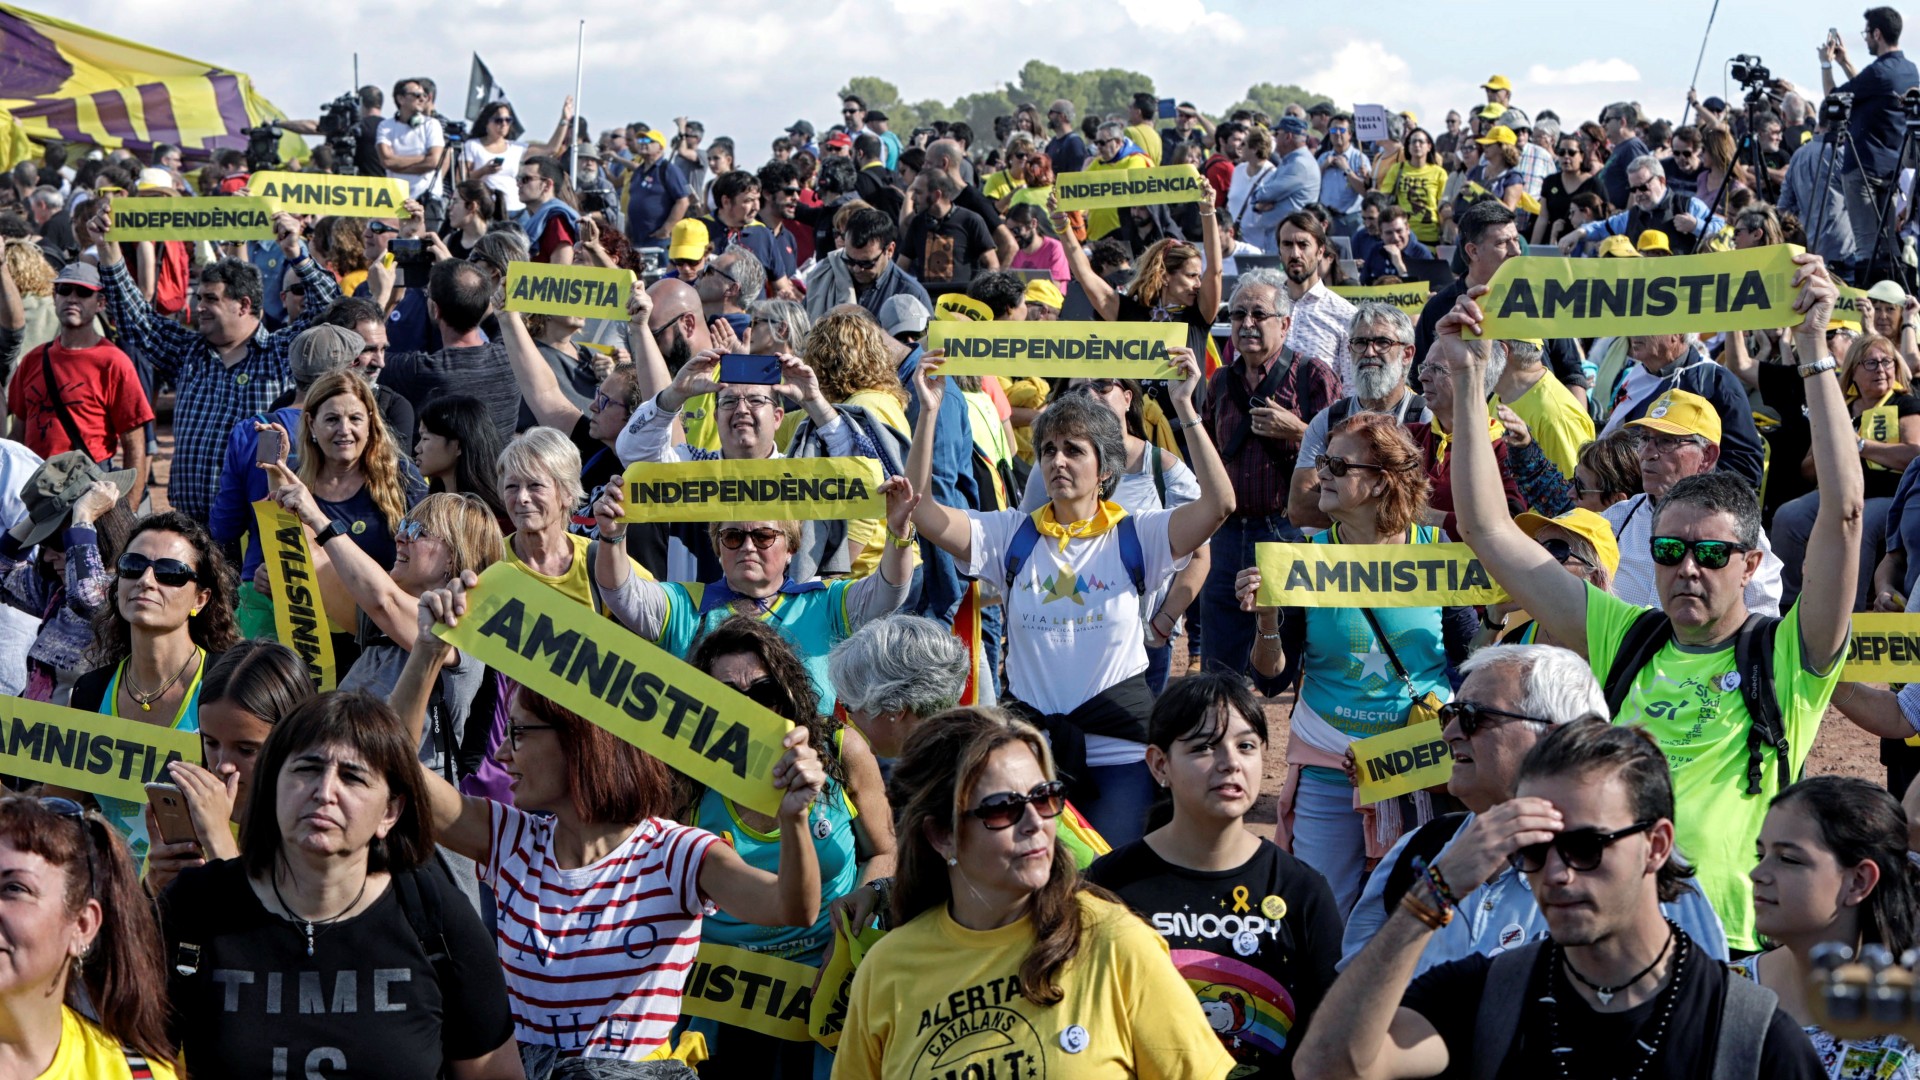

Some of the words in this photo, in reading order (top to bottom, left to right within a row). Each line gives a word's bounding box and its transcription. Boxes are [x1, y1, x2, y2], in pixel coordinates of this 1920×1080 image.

[262, 181, 394, 209] AMNISTIA
[1060, 176, 1199, 199] INDEPENDÈNCIA
[114, 207, 269, 228] INDEPENDÈNCIA
[512, 275, 619, 308] AMNISTIA
[1498, 270, 1771, 319] AMNISTIA
[944, 334, 1170, 361] INDEPENDÈNCIA
[631, 472, 869, 504] INDEPENDÈNCIA
[1284, 559, 1492, 593] AMNISTIA
[275, 526, 323, 691] MNISTIA
[1022, 613, 1047, 624] VIA
[478, 597, 750, 780] AMNISTIA
[0, 717, 183, 784] MNISTIA
[1366, 740, 1454, 782] INDEP
[1152, 912, 1281, 941] SNOOPY
[212, 967, 412, 1014] TIME
[916, 974, 1026, 1037] ALERTA
[927, 1011, 1017, 1057] CATALANS
